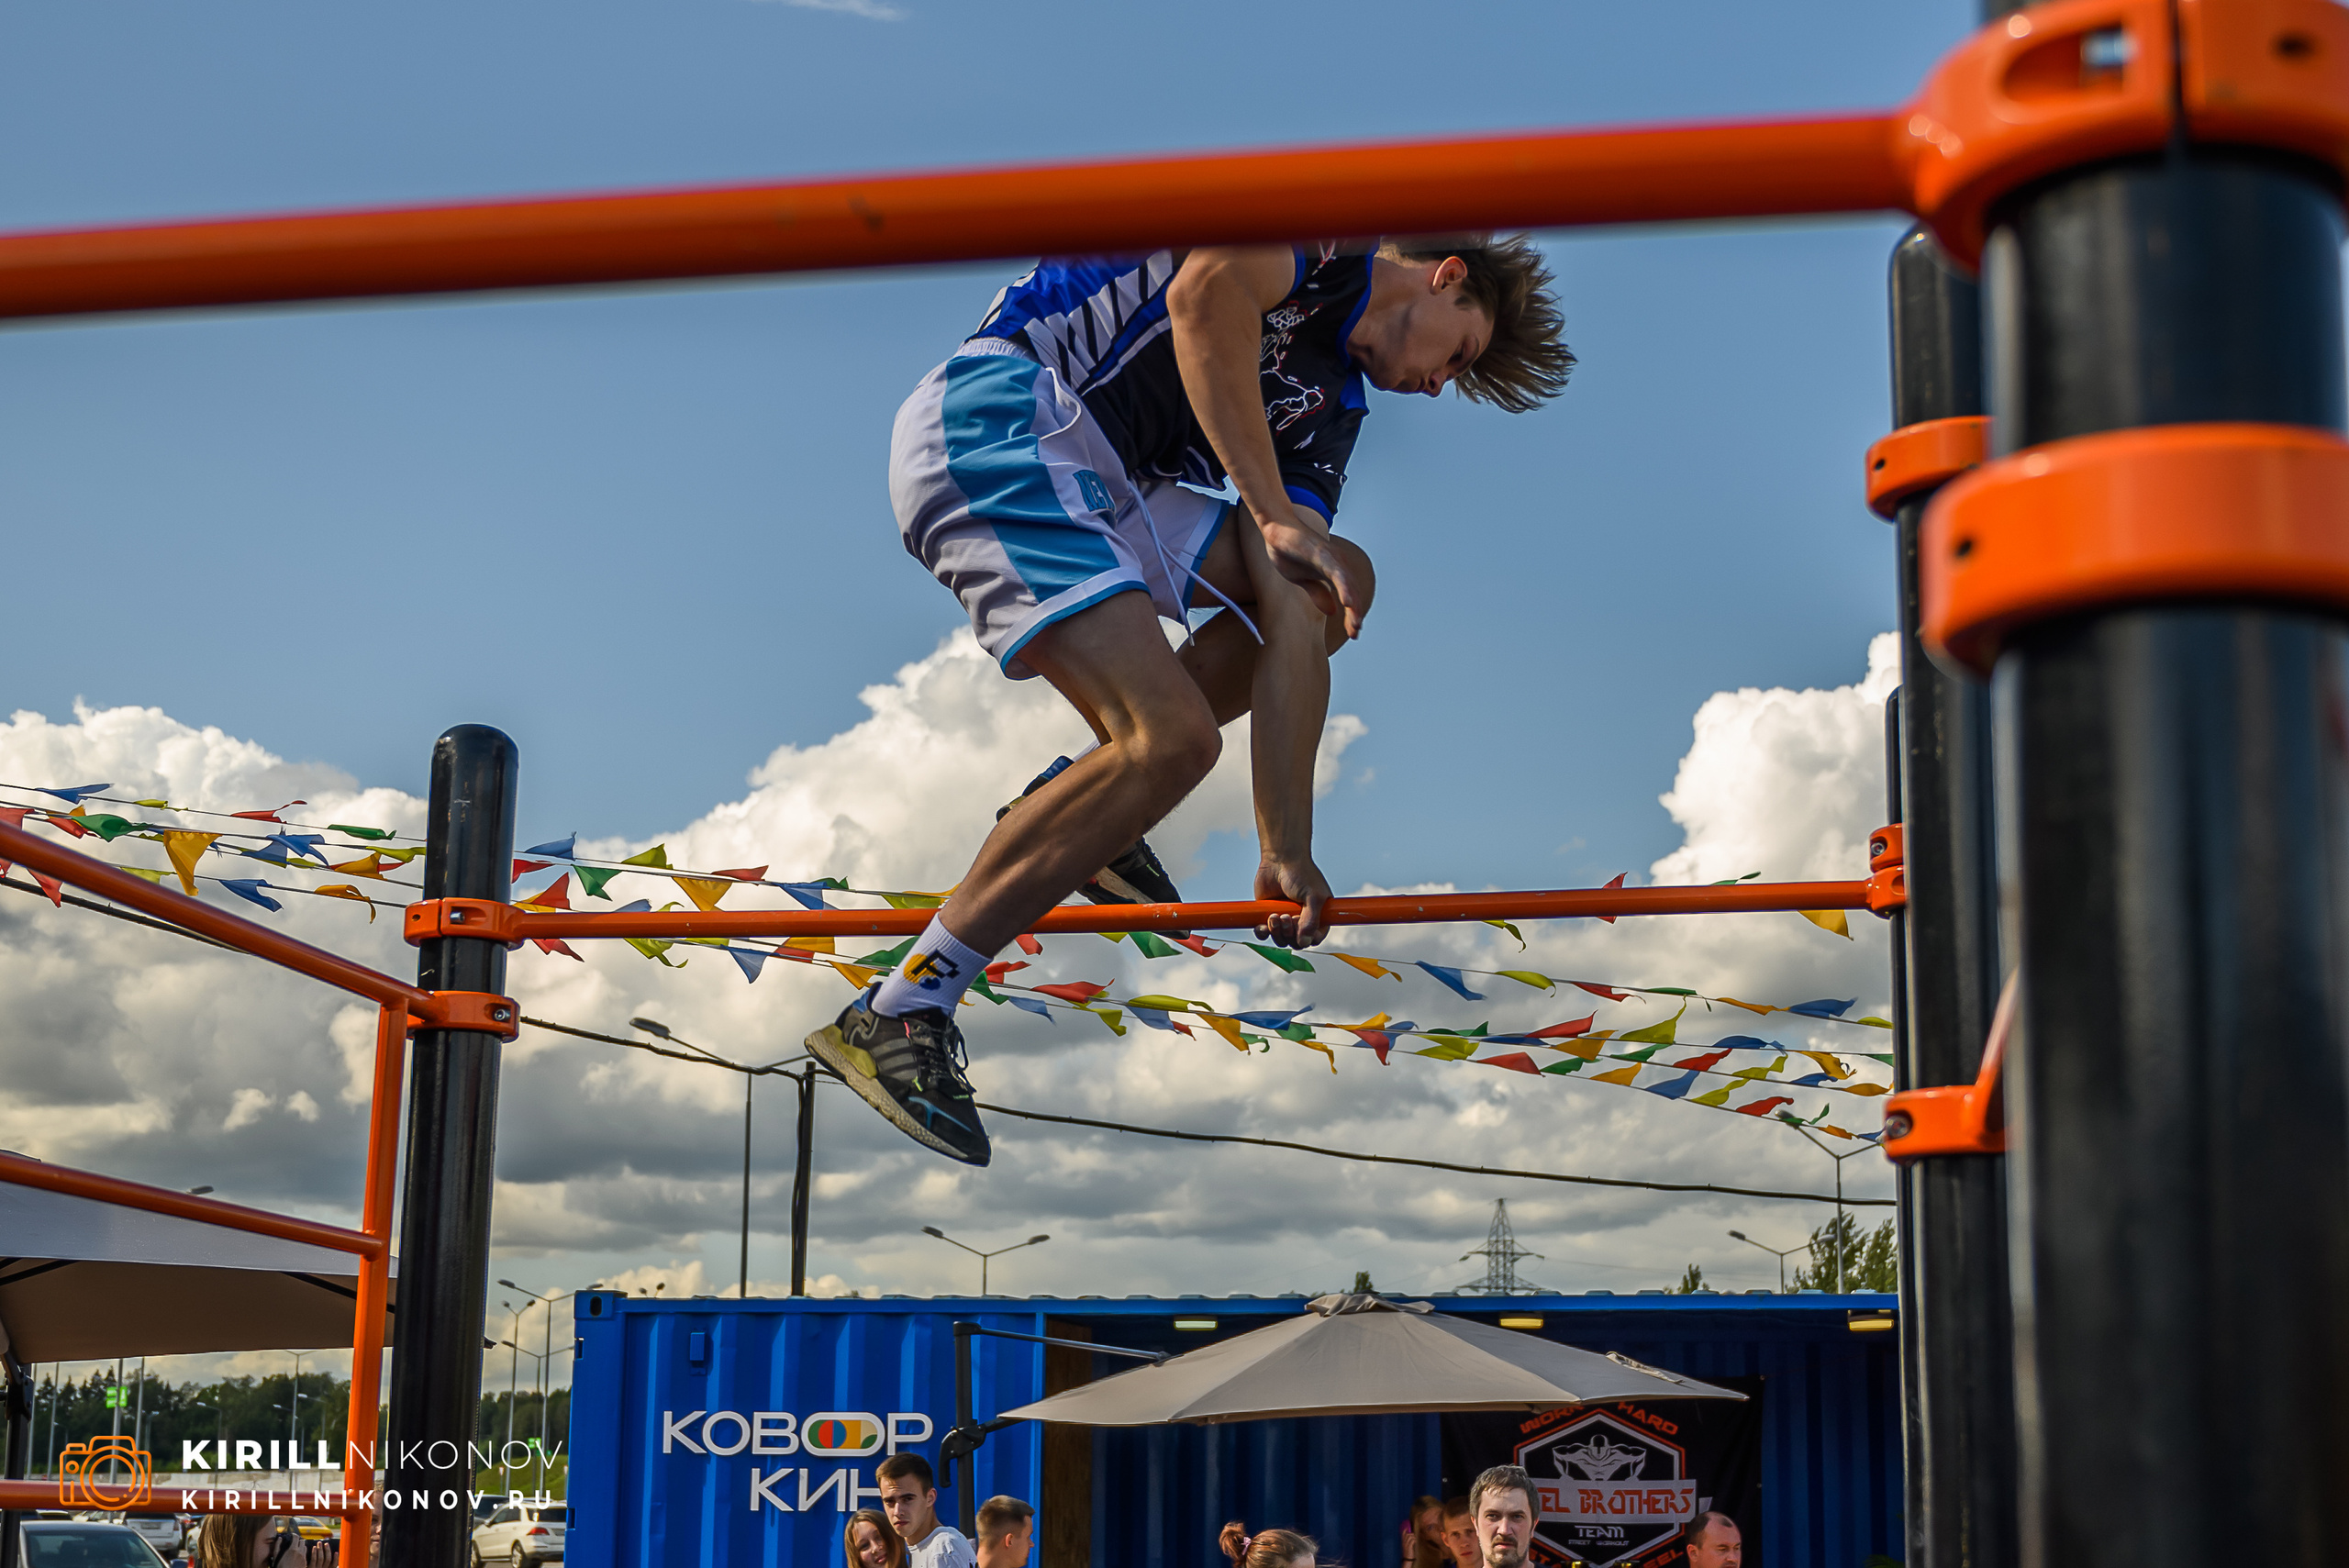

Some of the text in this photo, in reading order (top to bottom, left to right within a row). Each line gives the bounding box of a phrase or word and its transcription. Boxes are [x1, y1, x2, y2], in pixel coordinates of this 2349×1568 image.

[1618, 1401, 1679, 1436] HARD
[750, 1468, 882, 1512] КИН
[1577, 1488, 1695, 1515] BROTHERS
[1574, 1525, 1624, 1539] TEAM
